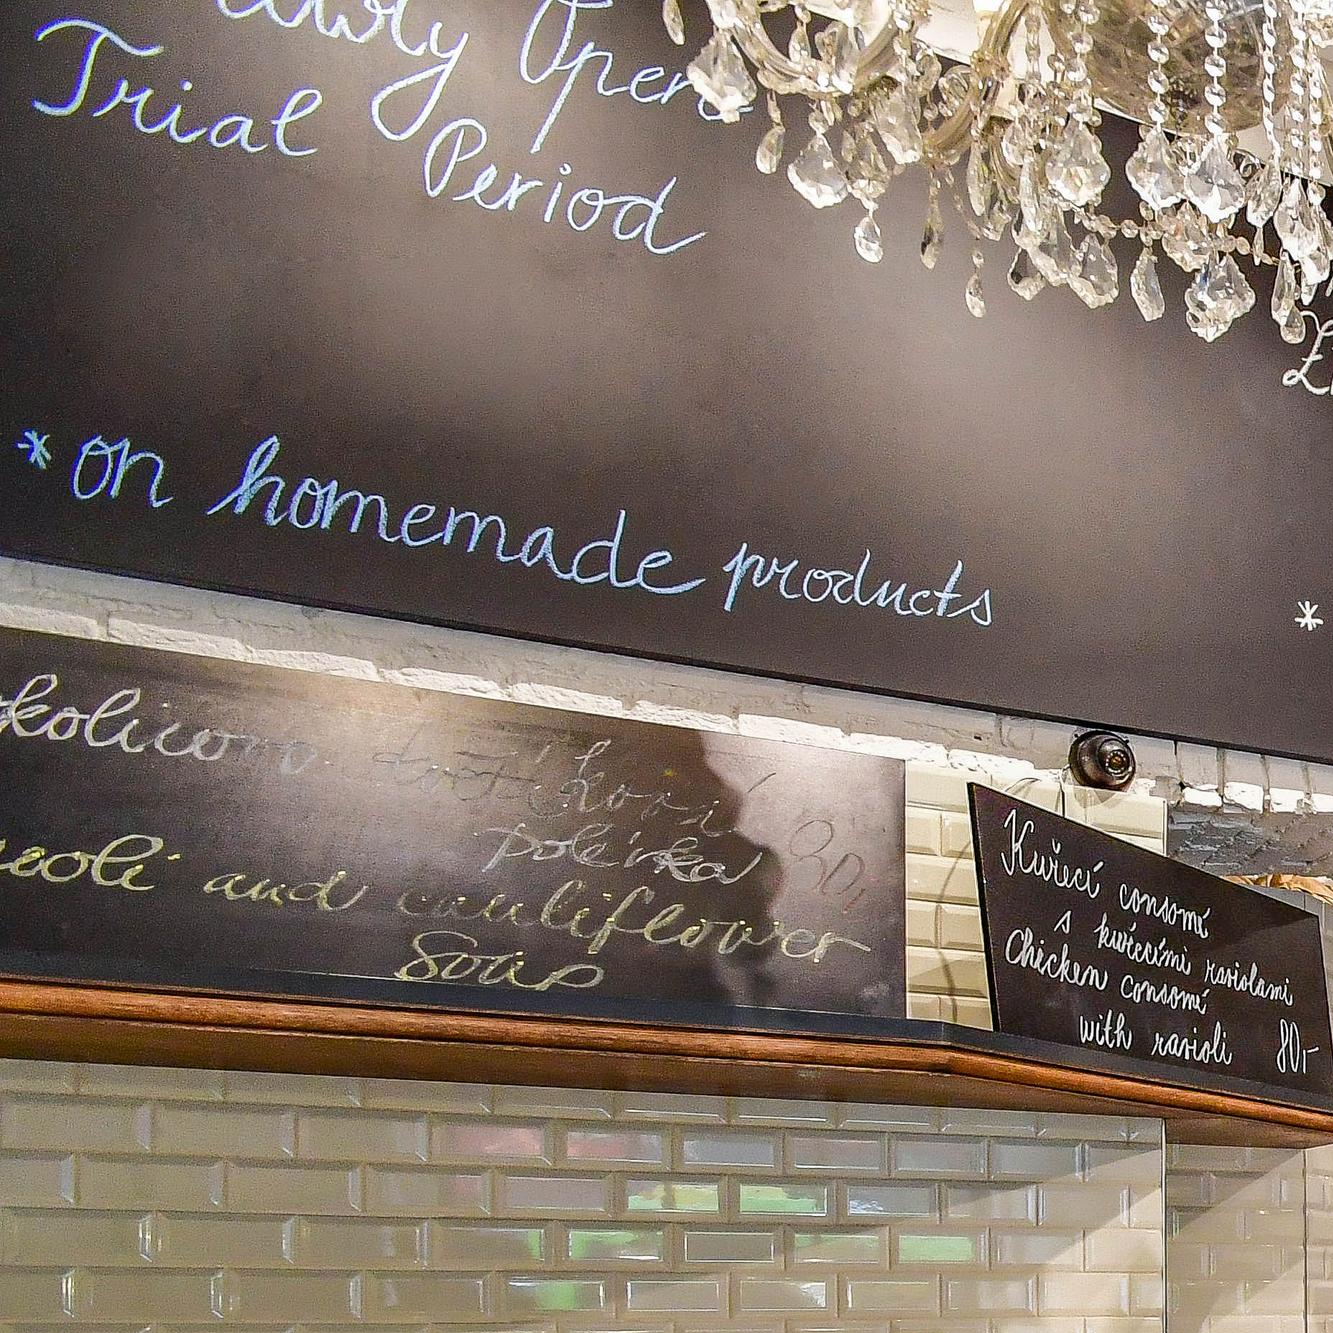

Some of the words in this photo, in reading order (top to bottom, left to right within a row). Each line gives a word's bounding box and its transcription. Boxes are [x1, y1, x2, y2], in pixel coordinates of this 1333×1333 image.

[35, 20, 322, 157] Trial
[424, 117, 707, 254] Period
[72, 439, 173, 506] on
[207, 436, 705, 594] homemade
[722, 541, 992, 627] products
[0, 834, 180, 891] coli
[204, 870, 369, 911] and
[399, 879, 871, 964] cauliflower
[1001, 808, 1104, 899] Kuřecí
[394, 931, 605, 991] Soup
[1005, 929, 1109, 992] Chicken
[1079, 1009, 1132, 1051] with
[1150, 1021, 1233, 1066] ravioli
[1276, 1019, 1320, 1075] 80,-
